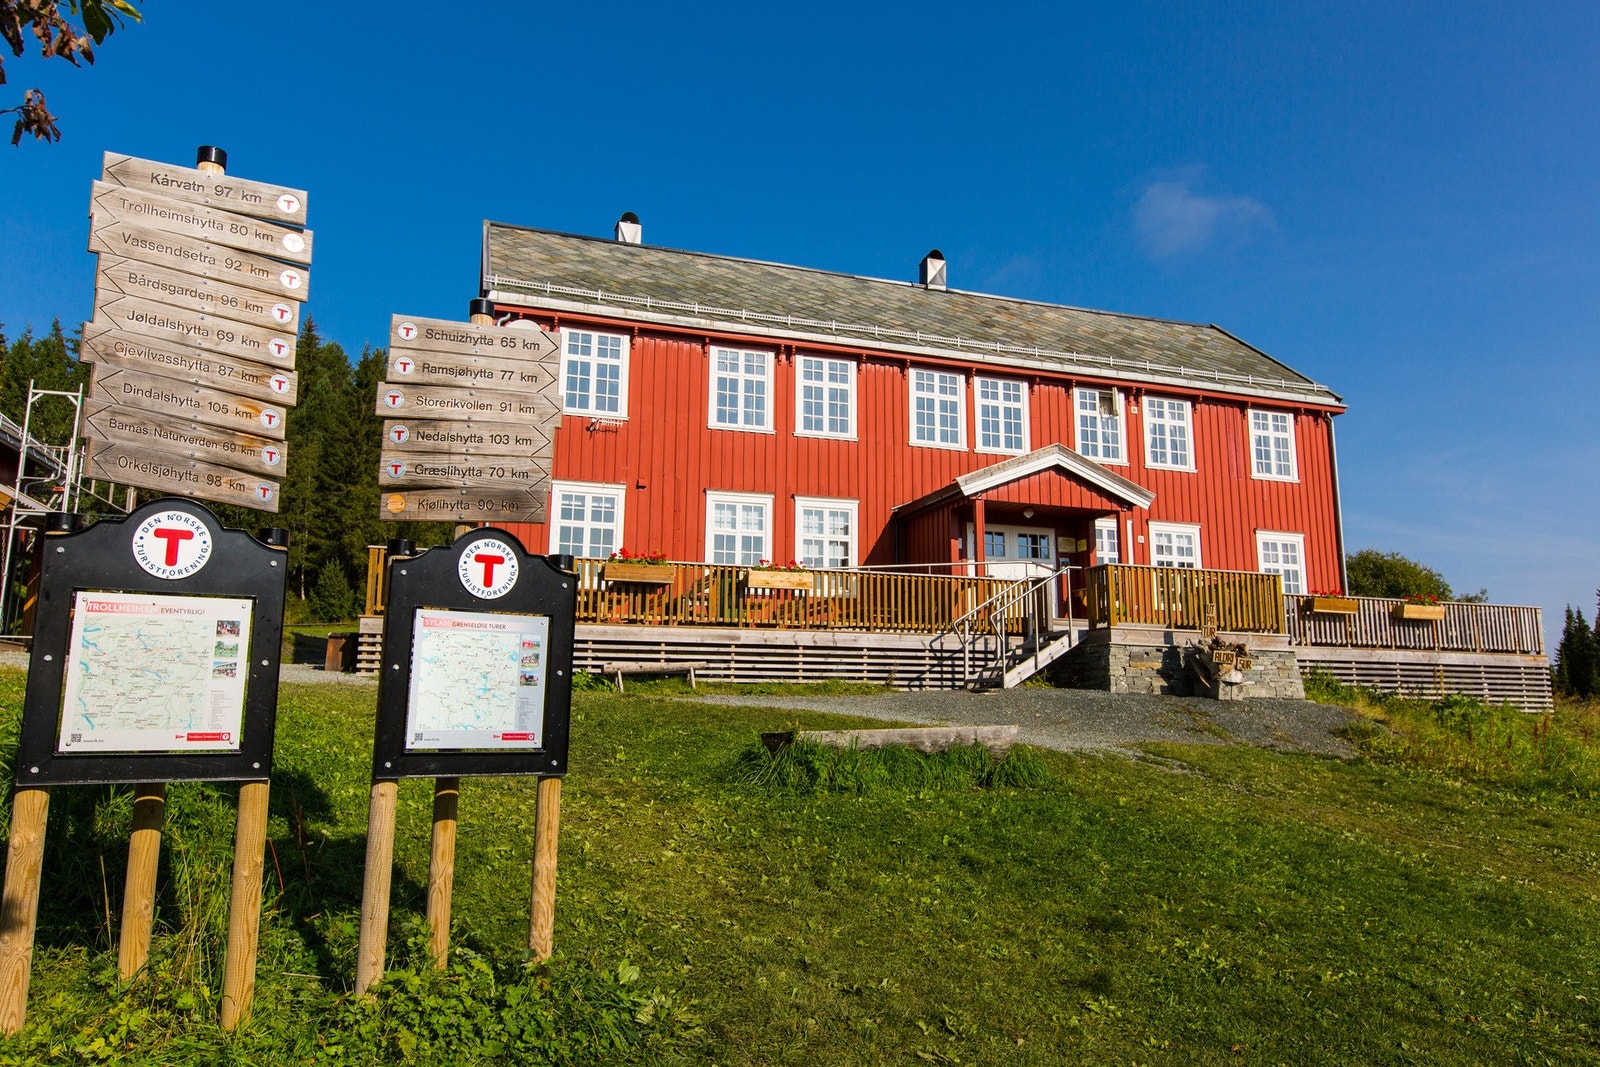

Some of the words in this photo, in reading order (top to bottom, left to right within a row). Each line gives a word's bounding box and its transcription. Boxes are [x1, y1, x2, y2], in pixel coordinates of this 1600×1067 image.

[150, 172, 205, 193] Kårvatn
[214, 184, 233, 198] 97
[241, 190, 262, 204] km
[283, 199, 294, 210] T
[119, 197, 224, 231] Trollheimshytta
[229, 223, 248, 236] 80
[254, 229, 274, 242] km
[121, 232, 216, 265] Vassendsetra
[224, 257, 242, 272] 92
[250, 263, 270, 278] km
[286, 275, 296, 285] T
[128, 272, 214, 302] Bårdsgarden
[221, 295, 238, 308] 96
[245, 300, 264, 313] km
[278, 308, 288, 318] T
[126, 310, 209, 338] Jøldalshytta
[216, 329, 235, 343] 69
[241, 335, 260, 349] km
[275, 343, 285, 354] T
[402, 326, 414, 337] T
[500, 336, 517, 348] 65
[522, 339, 540, 351] km
[113, 341, 210, 373] Gjevilvasshytta
[218, 365, 234, 377] 87
[241, 370, 259, 383] km
[275, 379, 286, 390] T
[399, 361, 411, 373] T
[421, 362, 494, 380] Ramsjøhytta
[500, 370, 515, 380] 77
[520, 371, 538, 383] km
[123, 382, 200, 409] Dindalshytta
[208, 401, 229, 415] 105
[235, 406, 252, 419] km
[265, 413, 276, 425] T
[388, 394, 400, 405] T
[416, 396, 493, 412] Storerikvollen
[499, 402, 513, 412] 91
[518, 403, 535, 414] km
[109, 418, 149, 435] Barnas
[154, 427, 218, 449] Naturverden
[222, 441, 236, 452] 69
[241, 445, 256, 457] km
[266, 450, 277, 462] T
[394, 430, 405, 440] T
[416, 430, 484, 445] Nedalshytta
[489, 434, 510, 445] 103
[515, 435, 532, 446] km
[117, 455, 199, 483] Orkelsjøhytta
[206, 474, 223, 487] 98
[229, 478, 246, 491] km
[260, 487, 270, 498] T
[391, 464, 402, 474] T
[414, 463, 483, 479] Græslihytta
[489, 467, 505, 478] 70
[511, 468, 529, 479] km
[417, 499, 470, 512] Kjølihytta
[477, 499, 494, 510] 90
[501, 500, 519, 511] km
[141, 517, 162, 534] DEN
[167, 514, 206, 537] NORSKE
[136, 543, 209, 576] TURISTFORENING
[154, 528, 194, 567] T
[465, 544, 480, 559] DEN
[484, 541, 514, 562] NORSKE
[461, 567, 516, 596] TURISTFORENING
[474, 553, 505, 588] T
